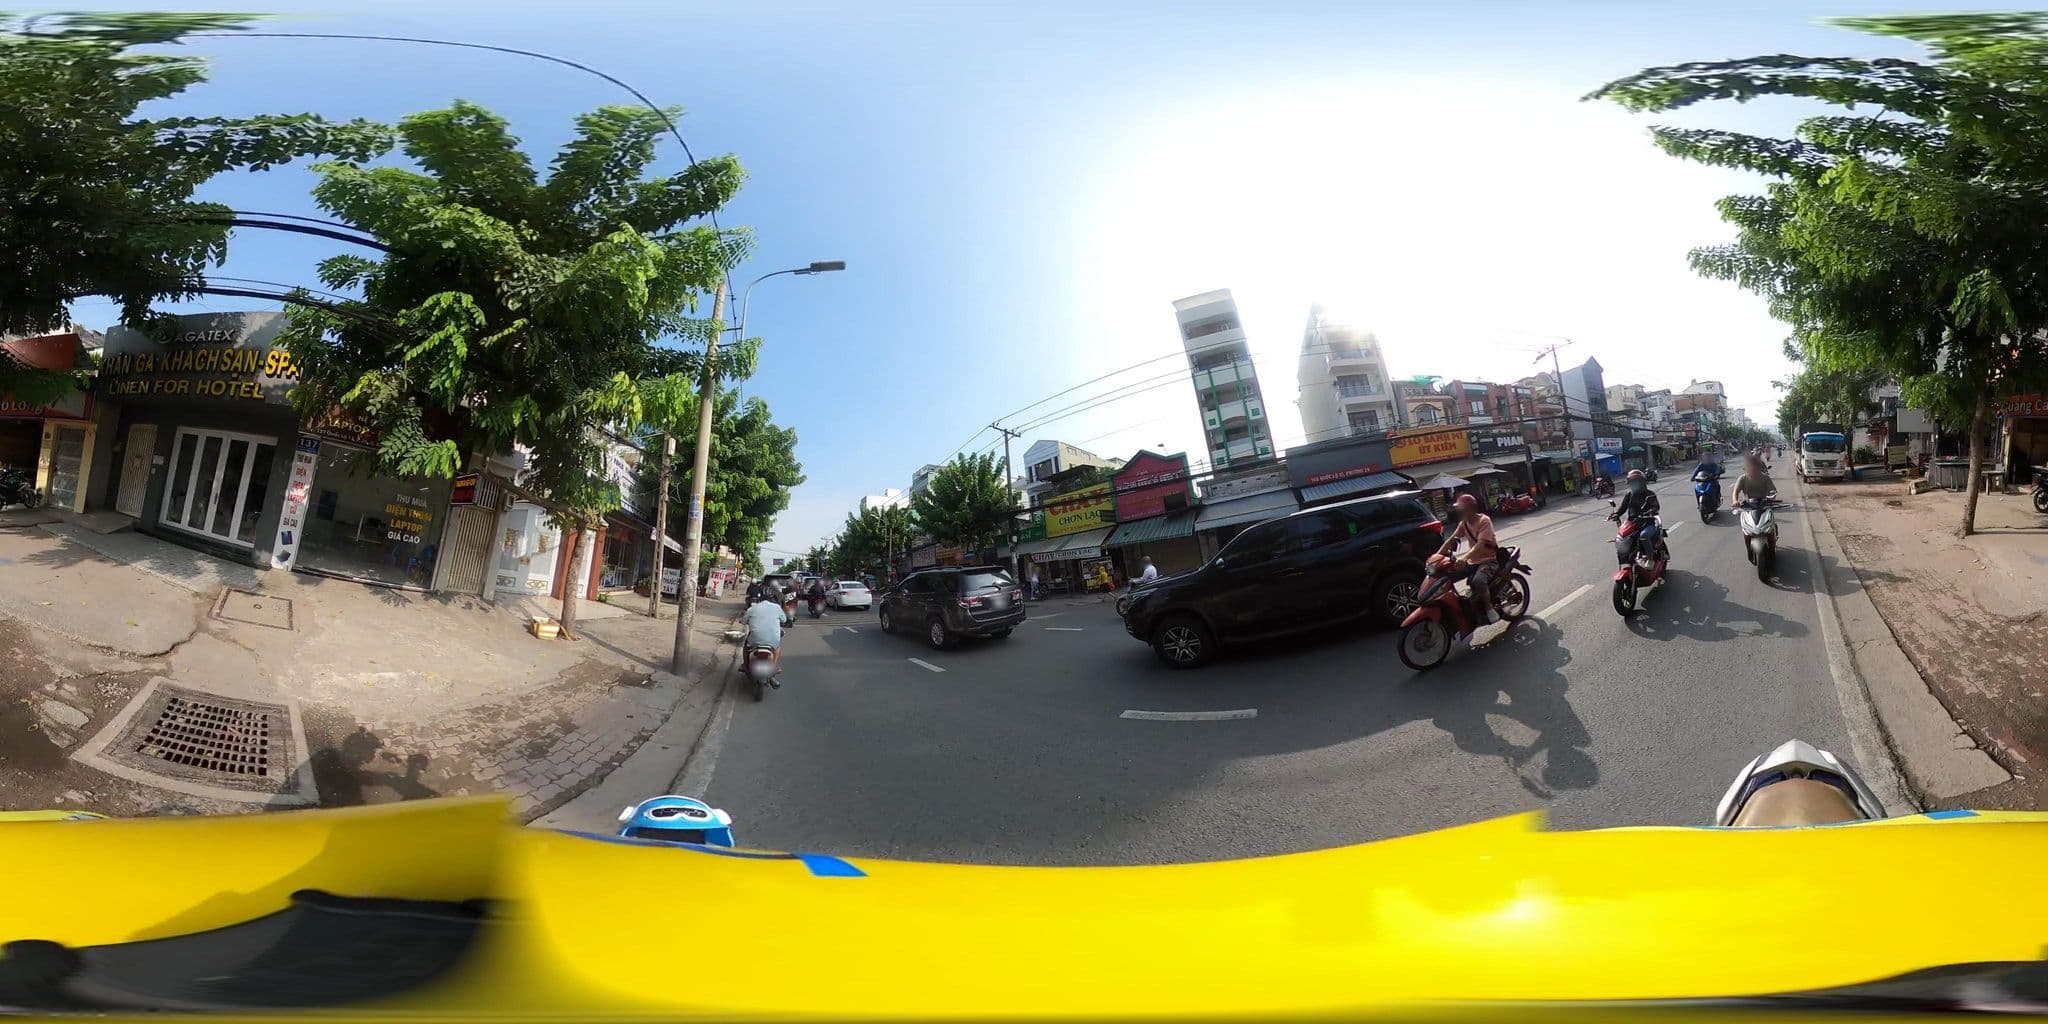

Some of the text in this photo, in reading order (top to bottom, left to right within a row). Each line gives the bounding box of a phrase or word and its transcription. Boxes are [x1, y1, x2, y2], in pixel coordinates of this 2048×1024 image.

[175, 328, 234, 343] AGATEX
[109, 380, 265, 399] LINEN FOR HOTEL
[328, 417, 369, 434] LAPTOP
[300, 438, 318, 448] 137
[396, 494, 427, 508] THU MUA
[390, 518, 423, 532] LAPTOP
[387, 530, 420, 544] GIÁ CAO
